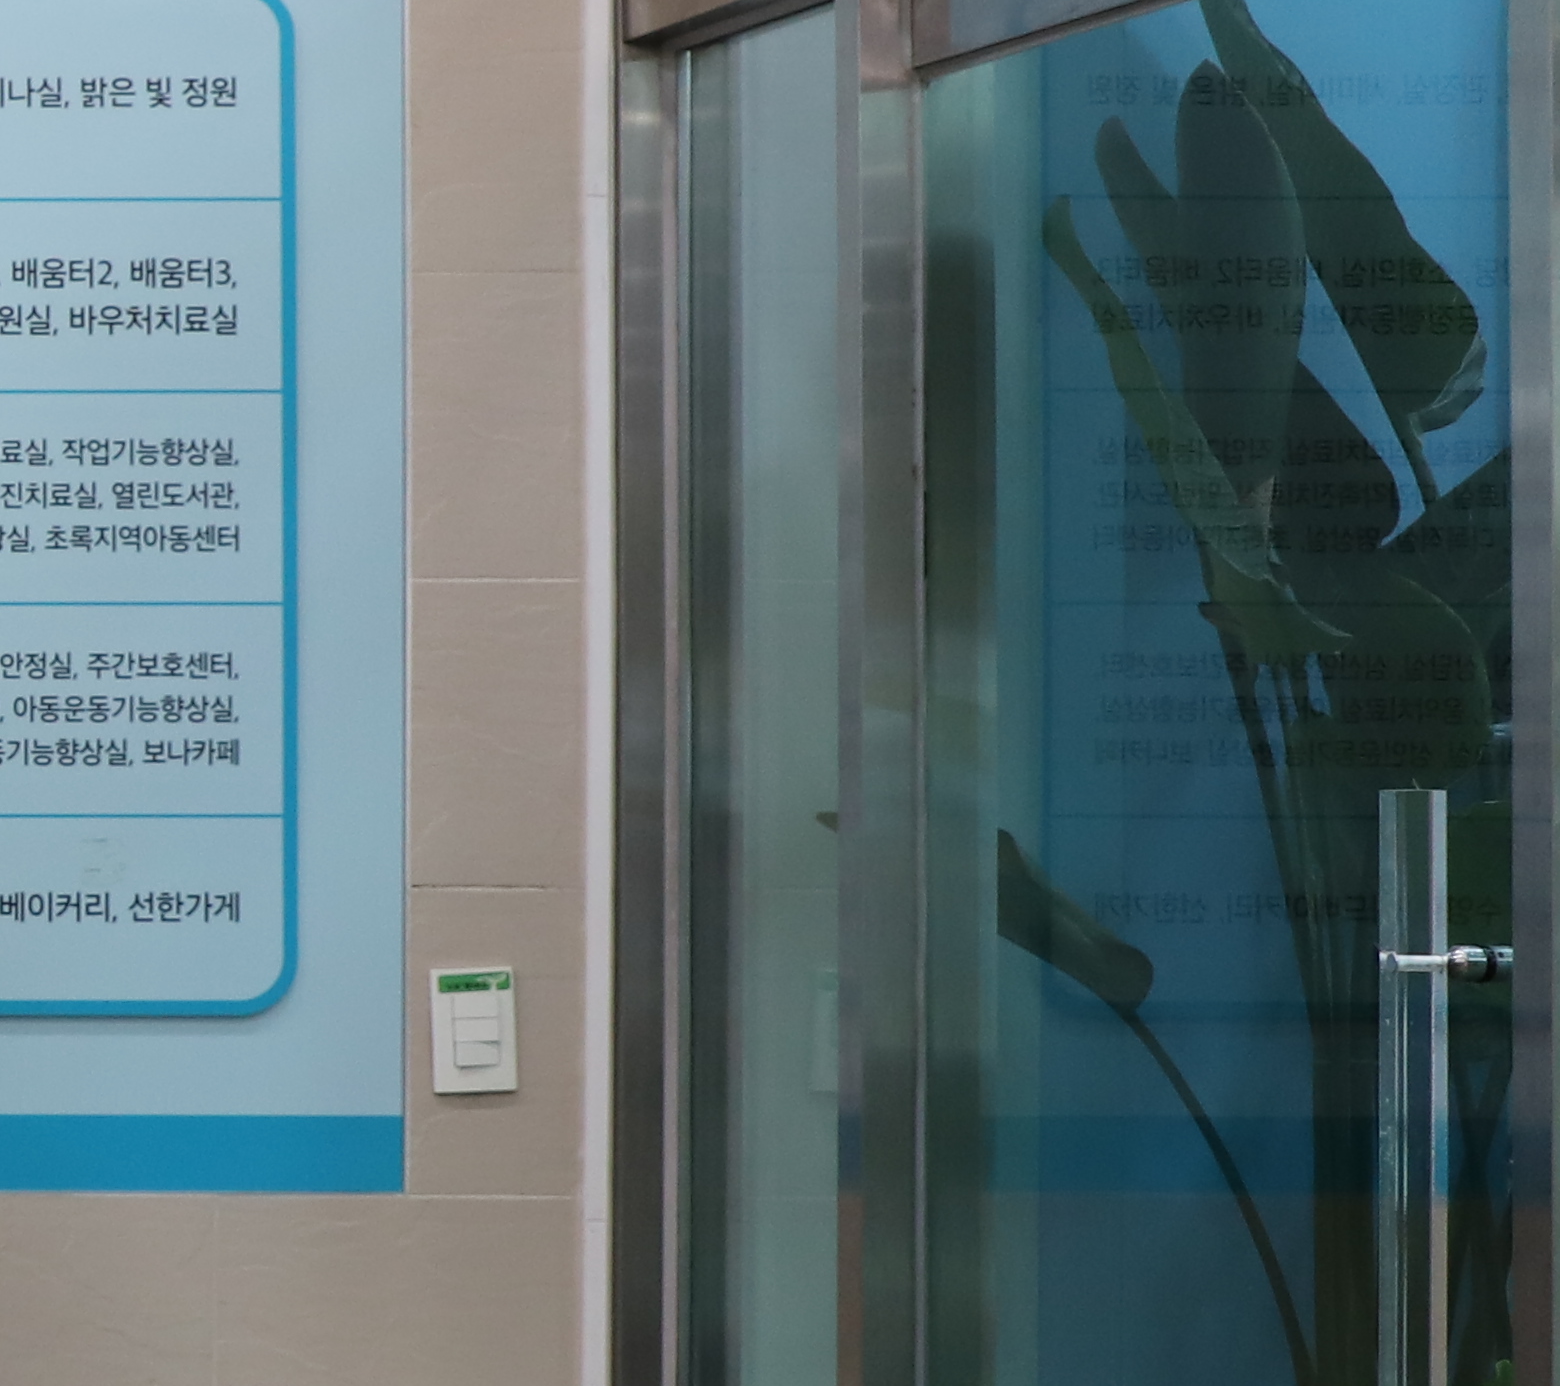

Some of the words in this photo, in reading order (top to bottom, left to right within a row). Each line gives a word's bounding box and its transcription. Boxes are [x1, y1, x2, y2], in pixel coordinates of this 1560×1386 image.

[81, 78, 135, 108] 밝은
[147, 77, 171, 108] 빛
[183, 77, 236, 107] 정원
[12, 259, 118, 288] 배움터2,
[131, 258, 236, 288] 배움터3,
[70, 305, 237, 335] 바우처치료실
[63, 438, 238, 466] 작업기능향상실,
[112, 482, 239, 509] 열린도서관,
[46, 525, 239, 552] 초록지역아동센터
[88, 653, 238, 679] 주간보호센터,
[13, 695, 238, 723] 아동운동기능향상실,
[143, 740, 239, 765] 보나카페
[129, 892, 239, 922] 선한가게
